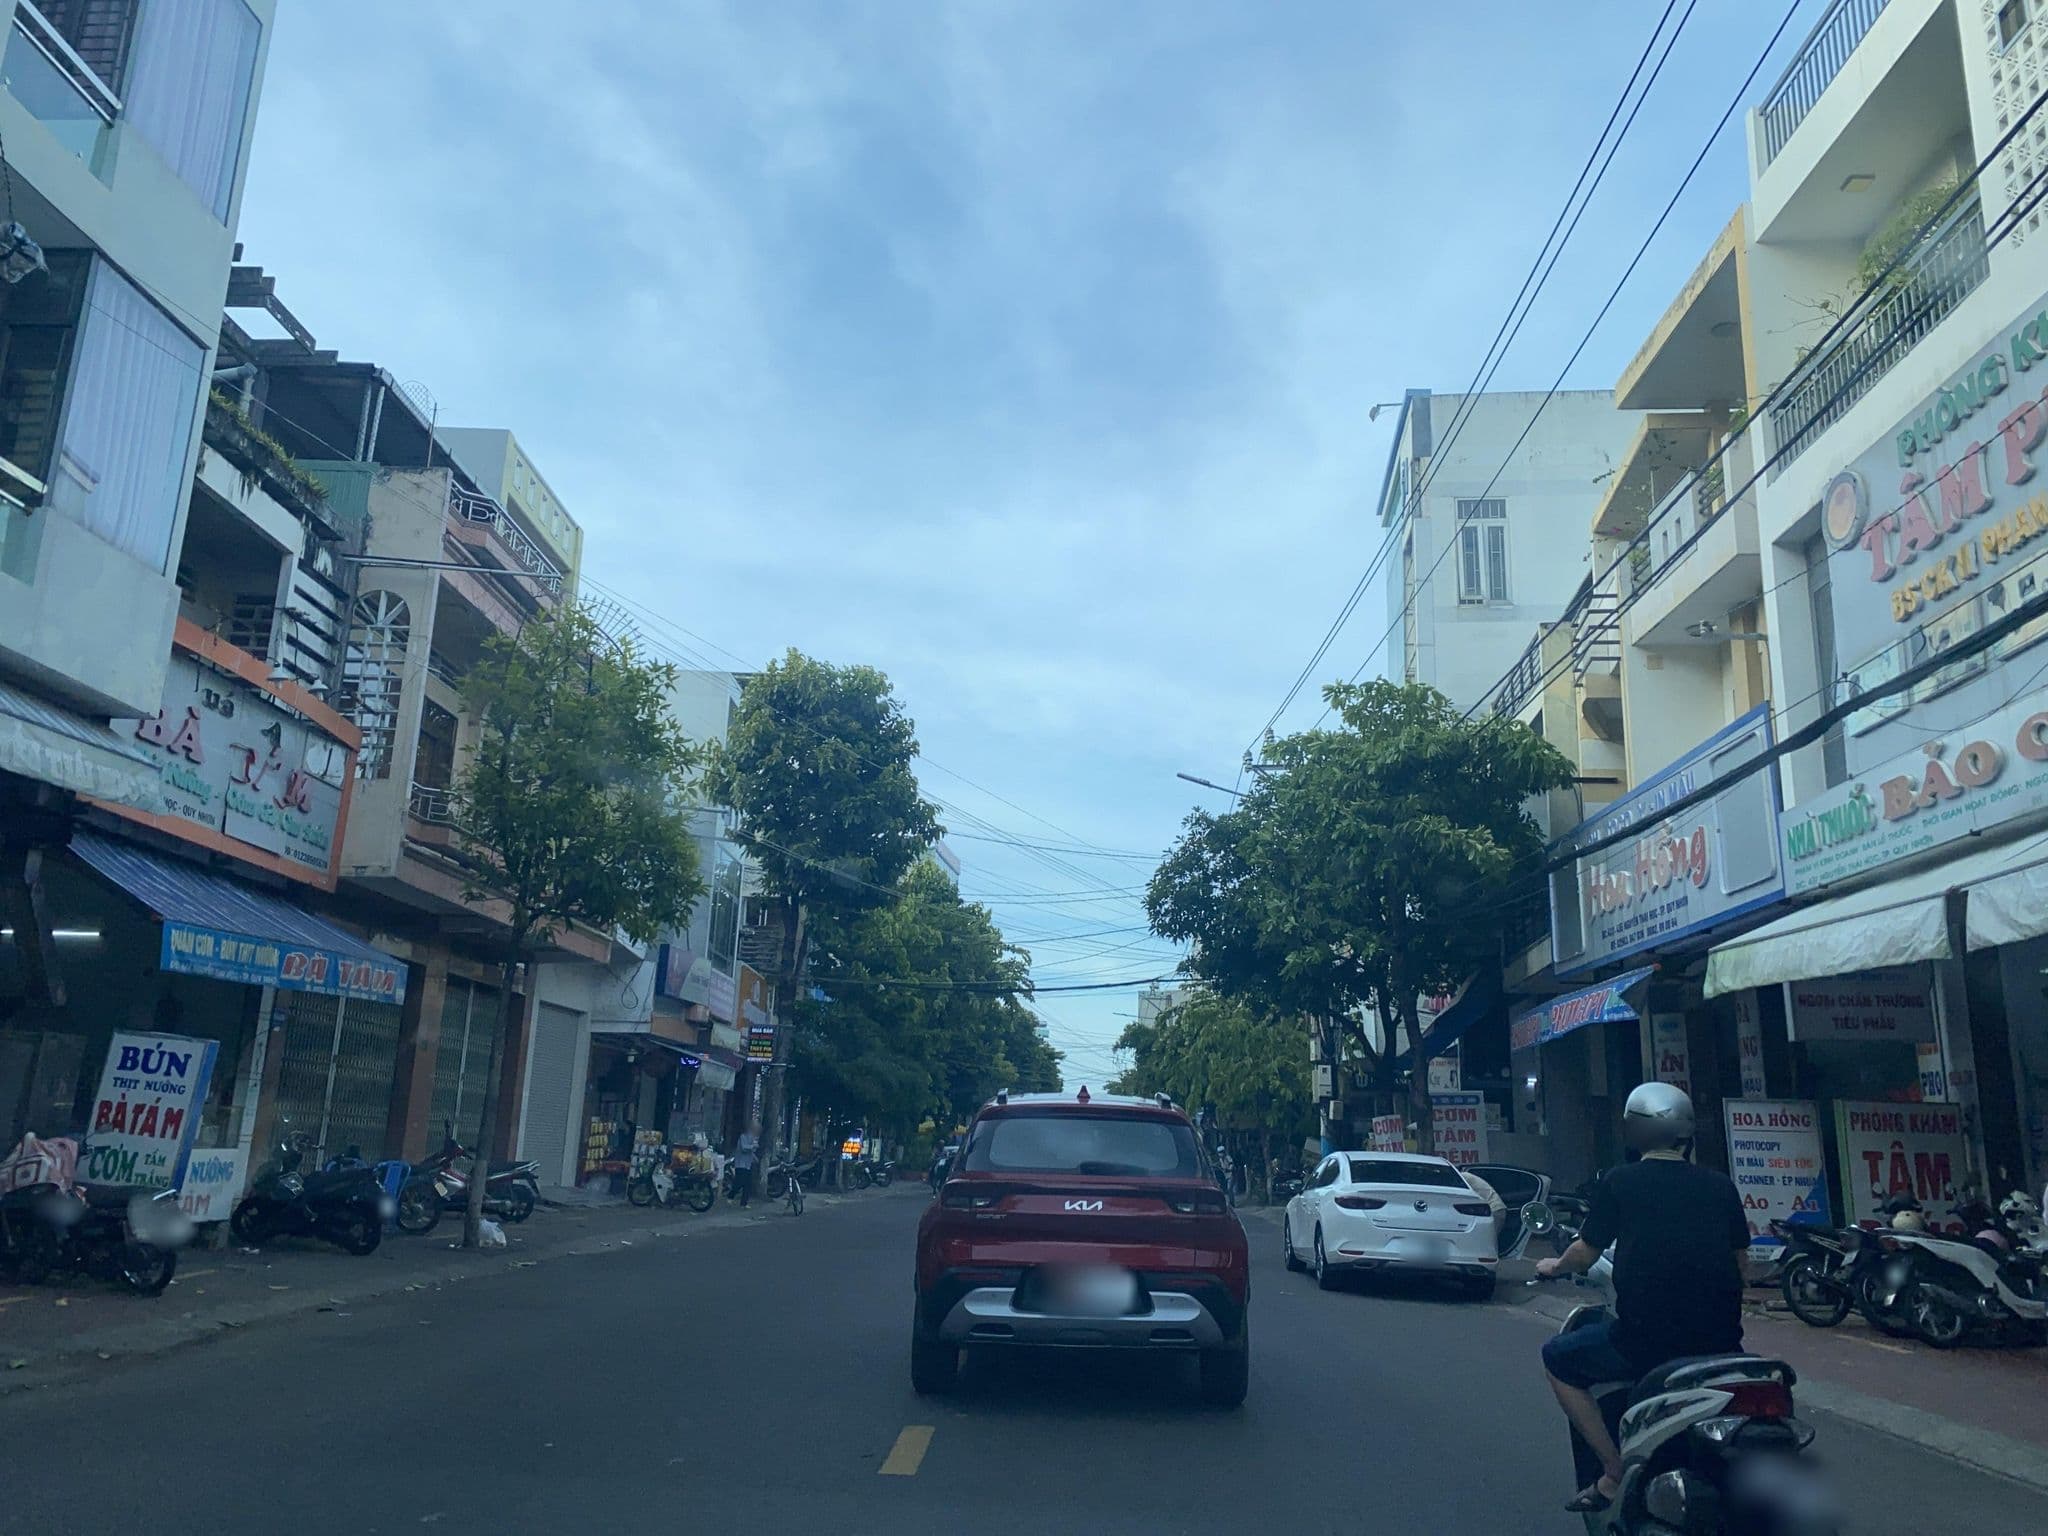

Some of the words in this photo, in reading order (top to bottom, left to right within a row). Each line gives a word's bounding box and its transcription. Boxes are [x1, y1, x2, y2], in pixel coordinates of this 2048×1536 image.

[1862, 441, 1993, 582] TÂM
[1880, 740, 2004, 822] BẢO
[280, 952, 328, 985] BÀ
[116, 1042, 193, 1079] BÚN
[94, 1093, 127, 1132] BÀ
[129, 1097, 185, 1140] TÁM
[1732, 1112, 1764, 1126] HOA
[1734, 1140, 1781, 1151] PHOTOCOPY
[1736, 1157, 1745, 1168] IN
[88, 1144, 138, 1183] CƠM
[1738, 1175, 1776, 1186] SCANNER
[1862, 1140, 1954, 1202] TÂM
[1065, 1200, 1103, 1211] KIA
